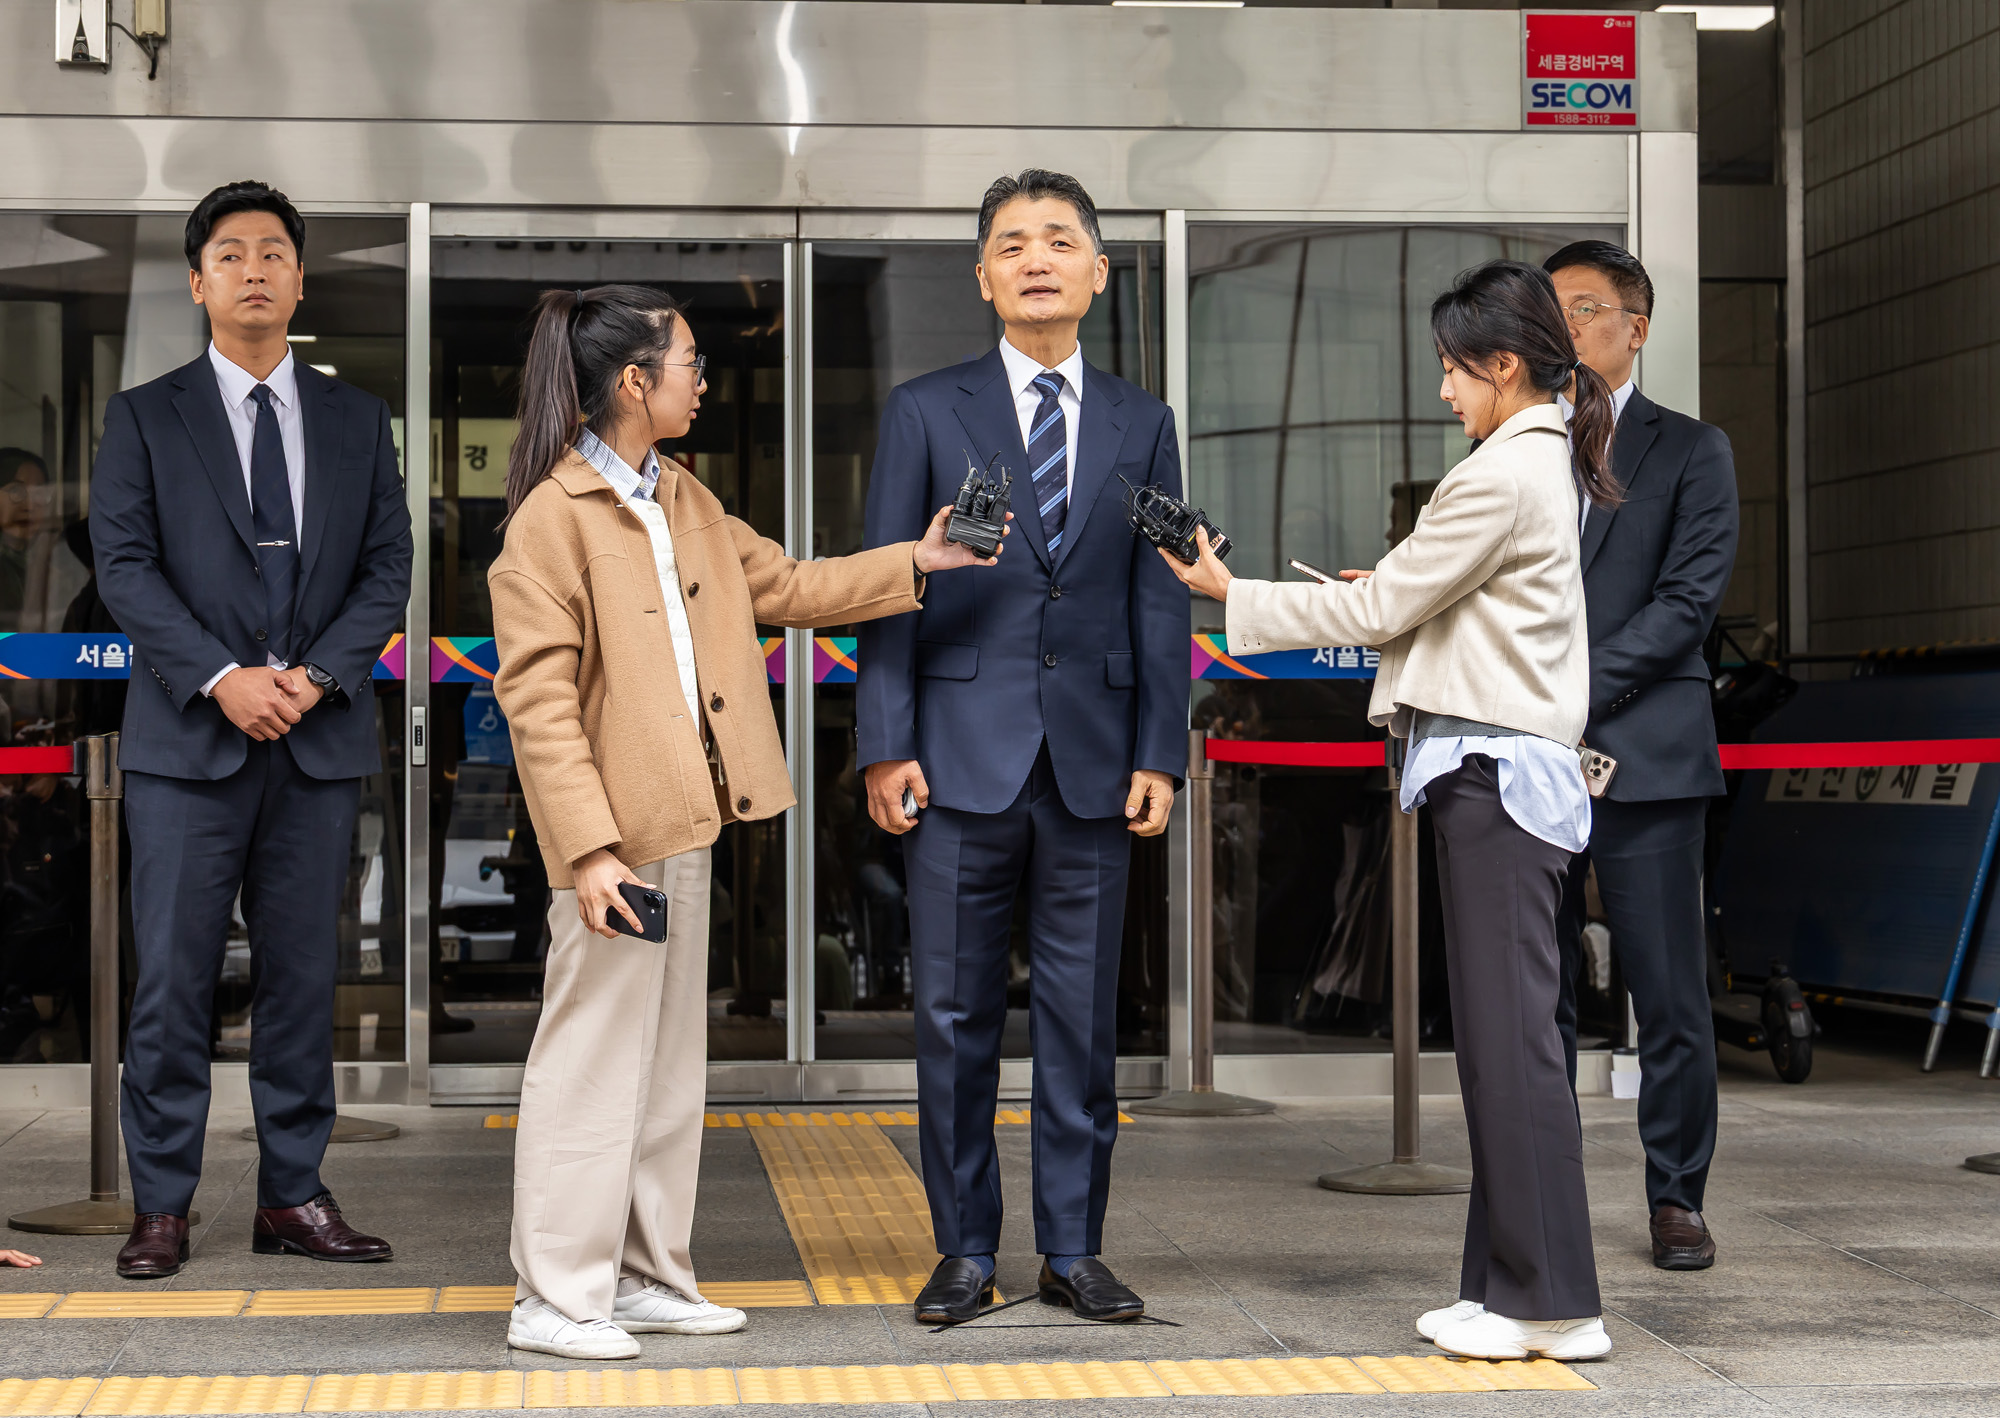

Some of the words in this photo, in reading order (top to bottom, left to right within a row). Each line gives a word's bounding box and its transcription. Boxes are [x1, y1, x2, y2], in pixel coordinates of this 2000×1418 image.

[1538, 54, 1624, 72] 세콤경비구역
[1531, 83, 1632, 109] SECOM
[1554, 114, 1611, 125] 1588-3112
[76, 643, 134, 668] 서울
